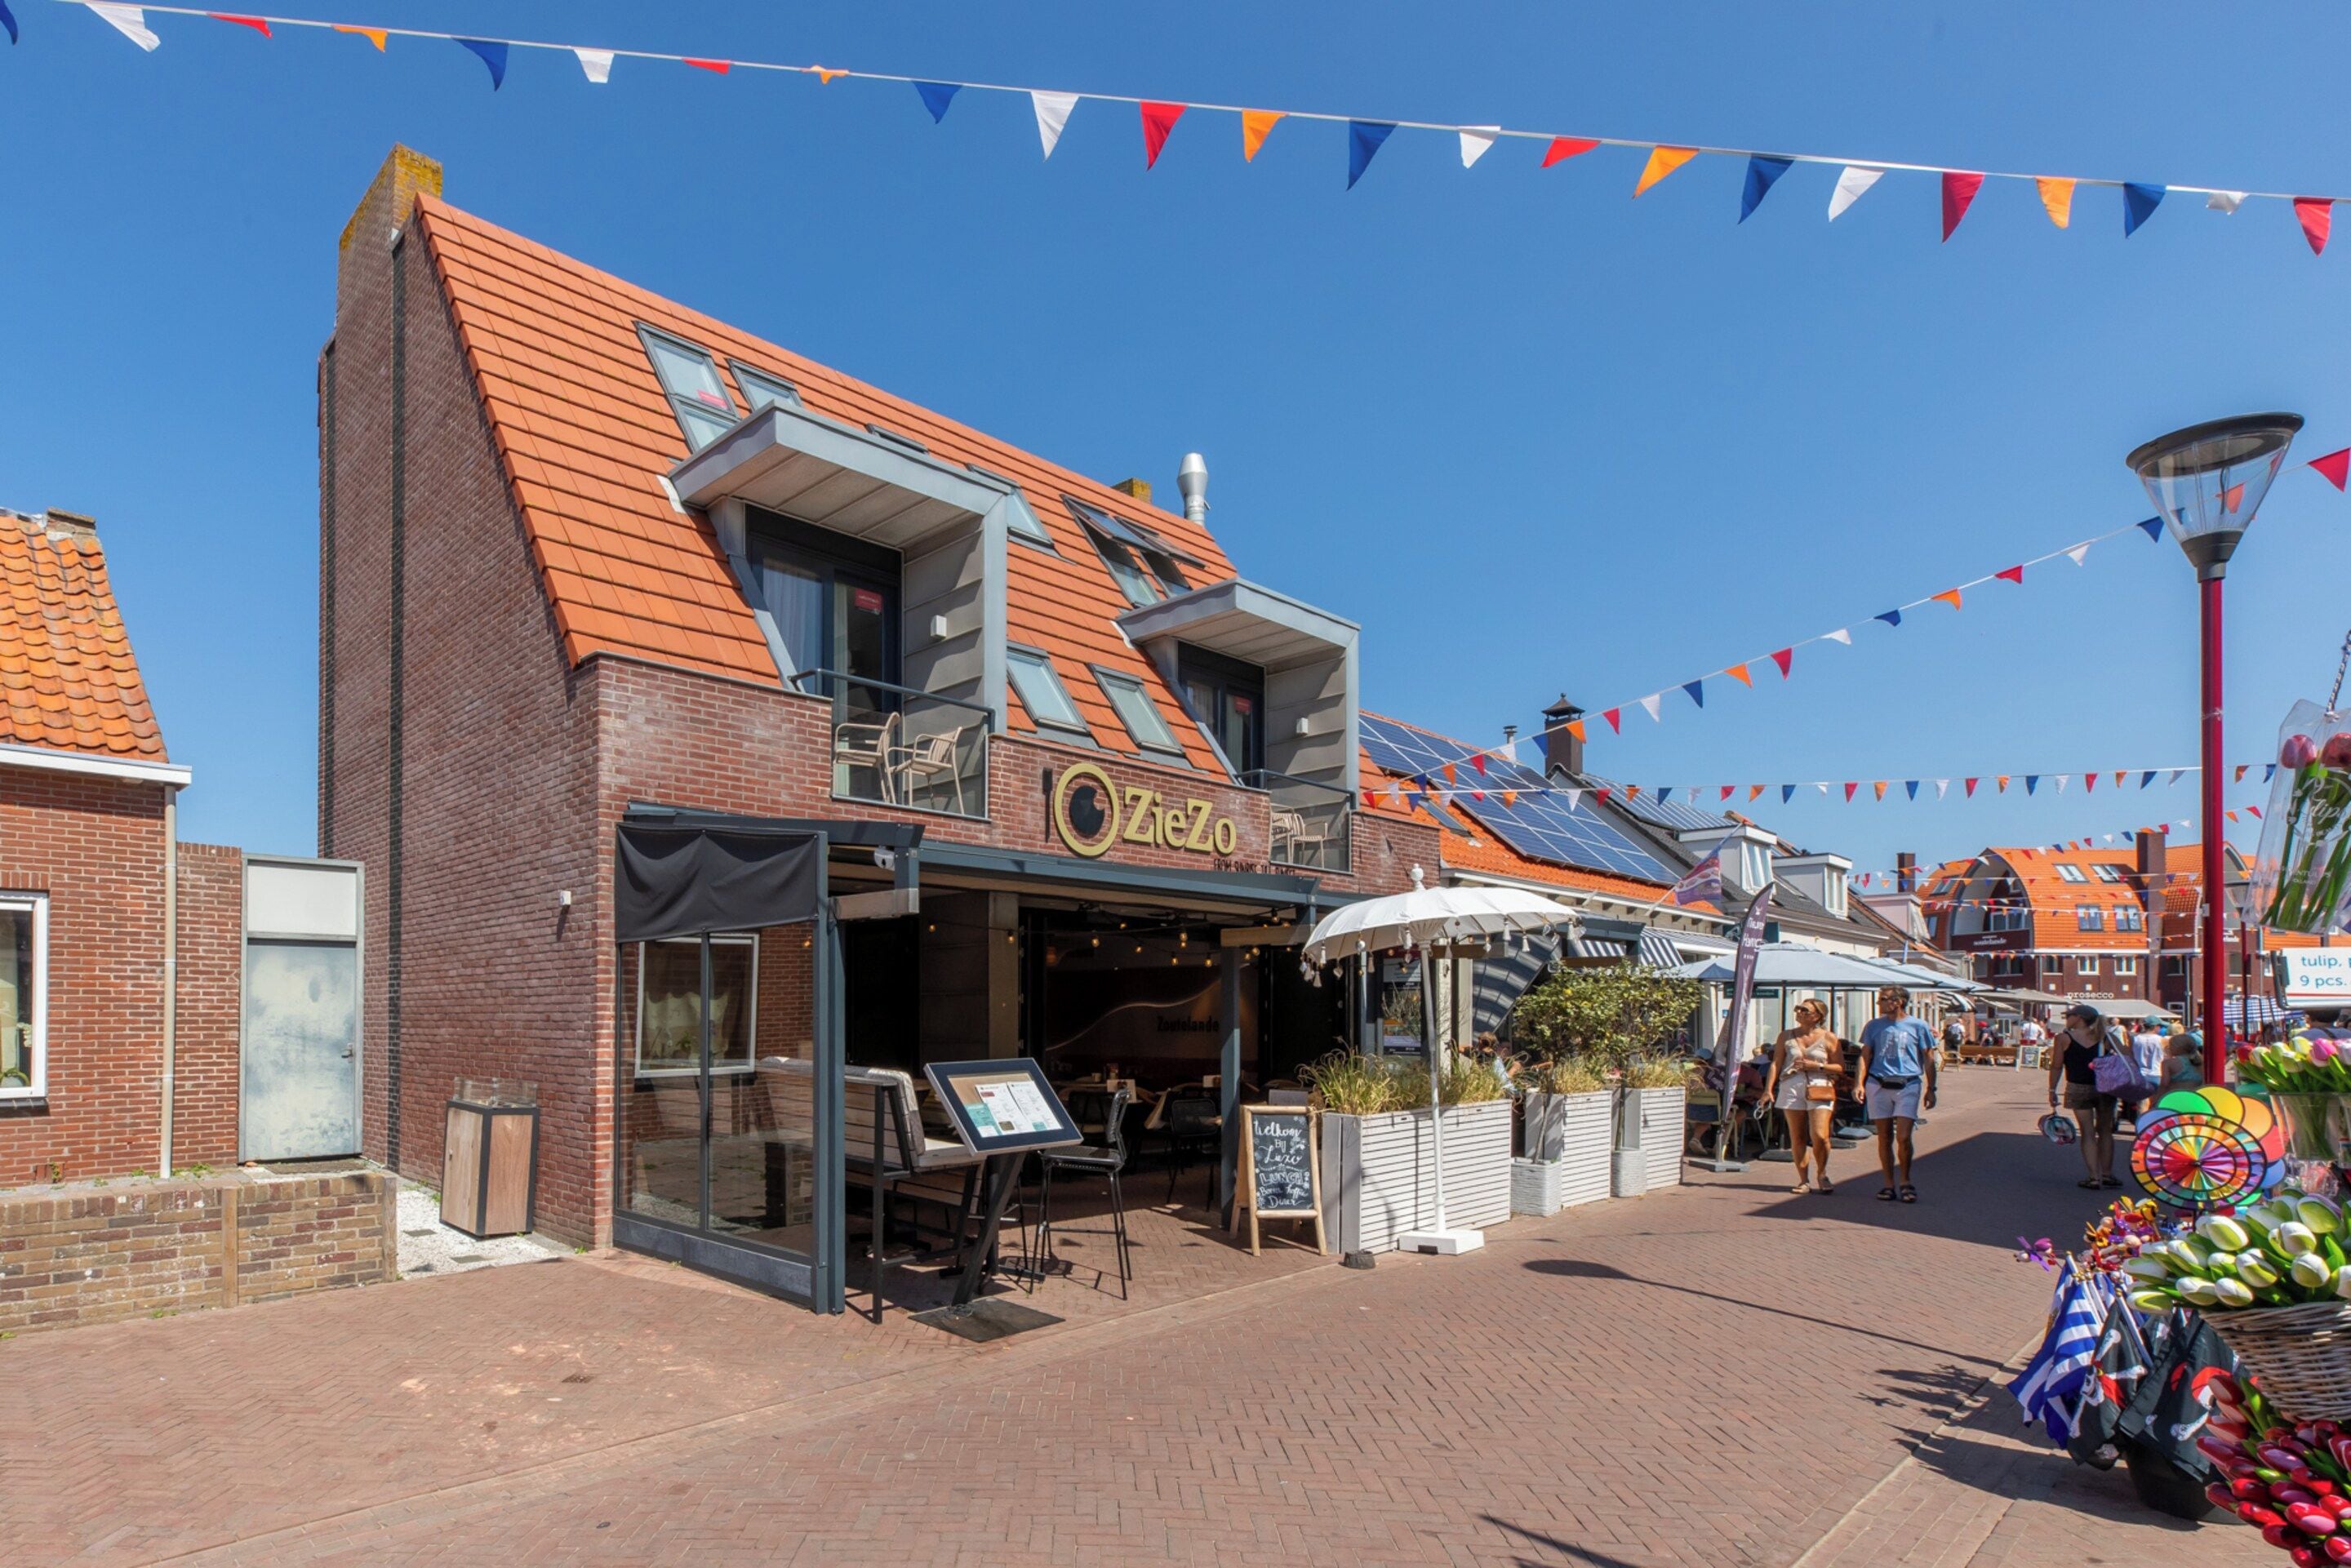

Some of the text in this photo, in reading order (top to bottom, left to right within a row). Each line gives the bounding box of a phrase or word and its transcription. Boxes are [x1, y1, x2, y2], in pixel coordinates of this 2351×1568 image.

[1122, 786, 1237, 855] ZieZo
[2301, 955, 2342, 969] tulip,
[2300, 975, 2348, 988] 9 pcs.
[2067, 992, 2114, 1000] prosecco
[1157, 1015, 1220, 1033] Zoutelande
[1259, 1171, 1304, 1186] LUNCH
